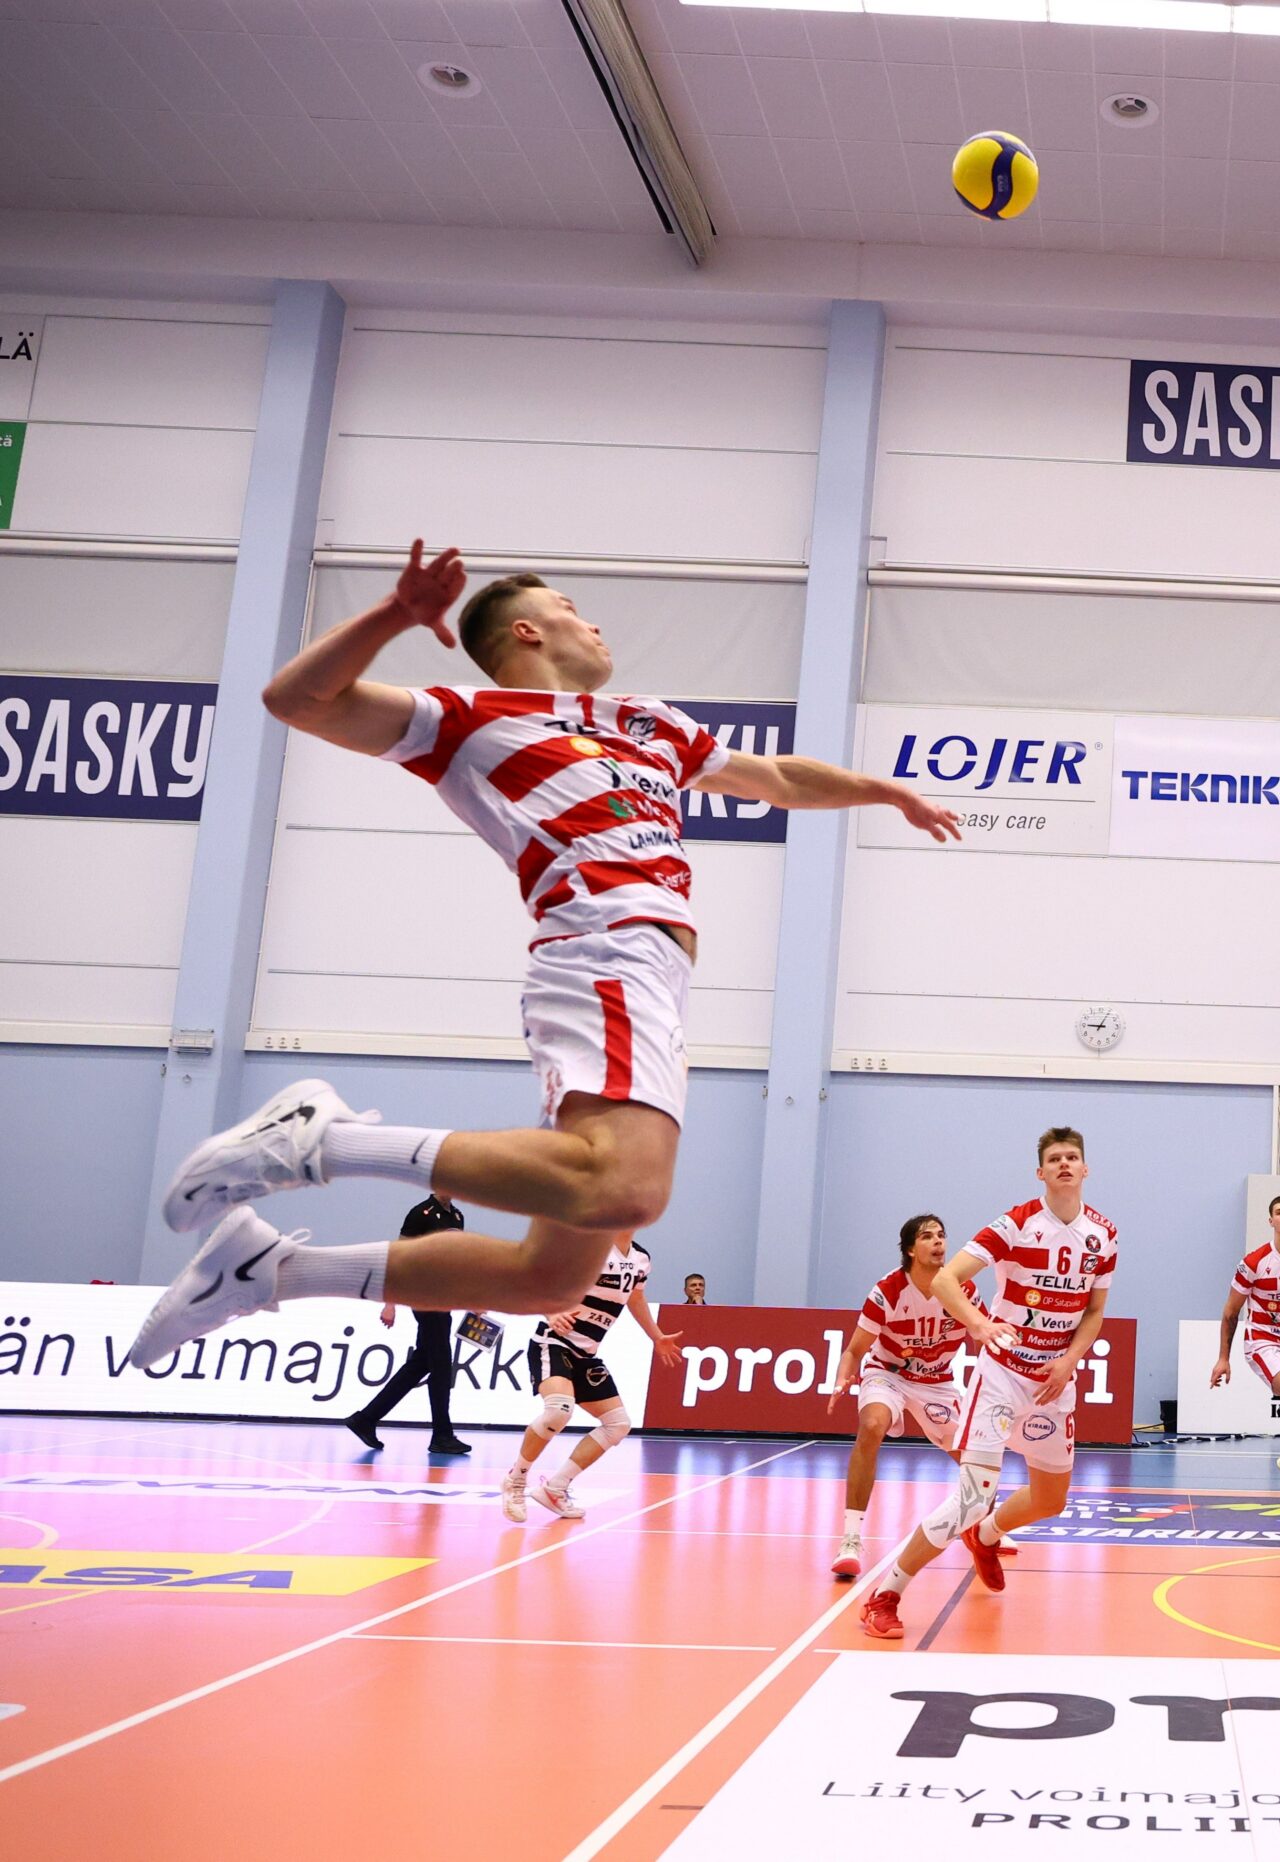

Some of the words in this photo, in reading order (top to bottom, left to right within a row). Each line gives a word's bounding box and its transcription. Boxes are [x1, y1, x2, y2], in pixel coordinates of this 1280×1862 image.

[0, 697, 216, 798] SASKY
[892, 733, 1088, 790] LOJER
[955, 811, 998, 834] easy
[1005, 814, 1047, 831] care
[619, 1261, 634, 1272] pro
[1056, 1245, 1072, 1275] 6
[1032, 1274, 1087, 1291] TELILÄ
[918, 1316, 935, 1337] 11
[1065, 1413, 1075, 1439] 6
[821, 1781, 988, 1804] Liity
